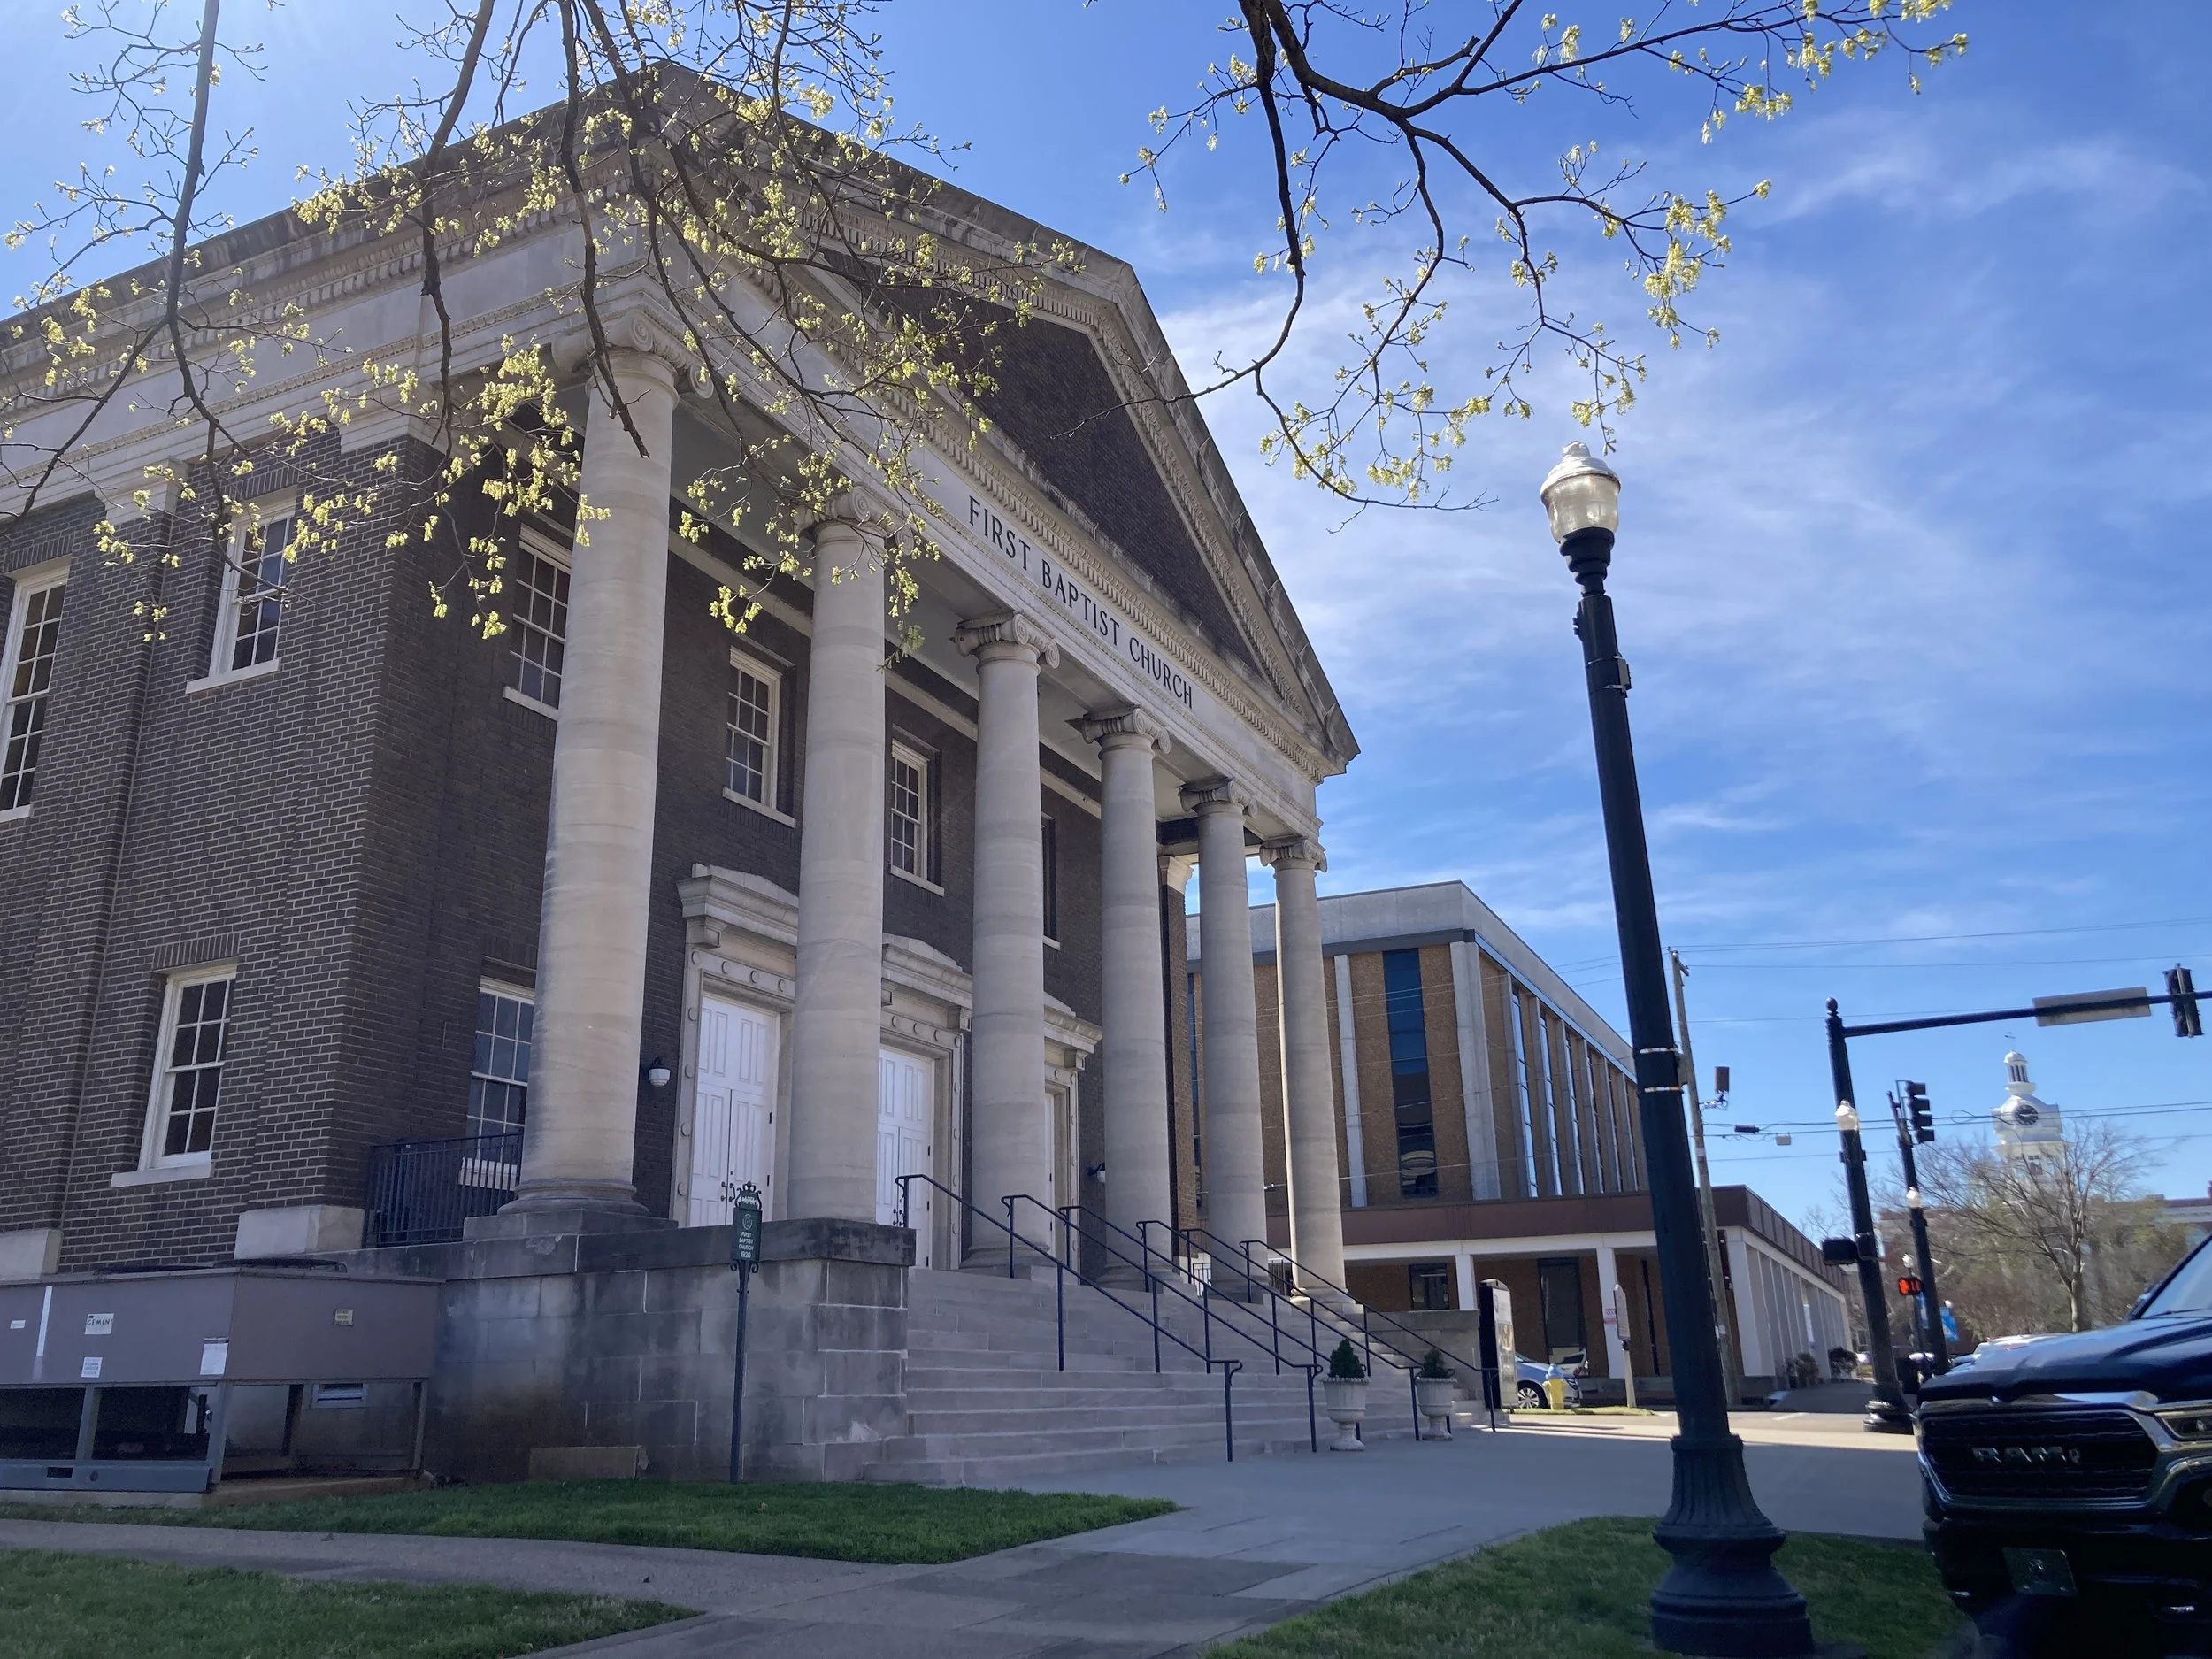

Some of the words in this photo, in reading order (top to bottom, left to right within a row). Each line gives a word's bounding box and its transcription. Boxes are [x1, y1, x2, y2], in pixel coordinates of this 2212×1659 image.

[968, 495, 1031, 571] FIRST
[1041, 558, 1120, 646] BAPTIST
[1129, 637, 1193, 709] CHURCH
[1971, 1446, 2067, 1464] RAM
